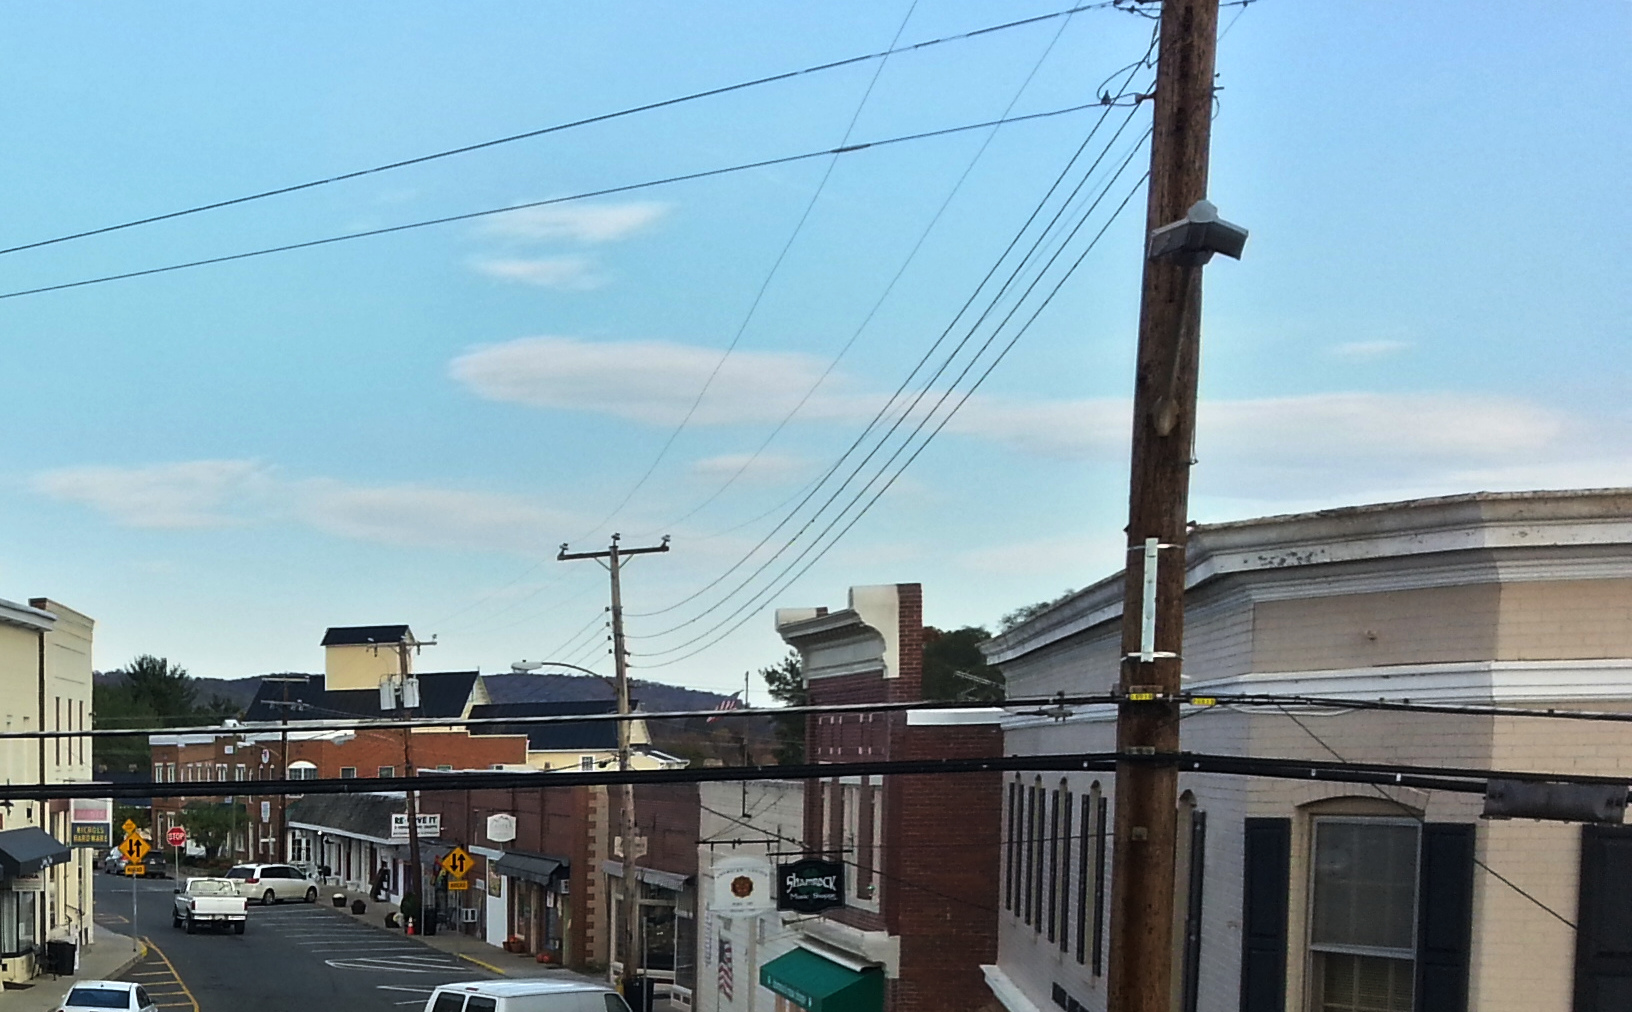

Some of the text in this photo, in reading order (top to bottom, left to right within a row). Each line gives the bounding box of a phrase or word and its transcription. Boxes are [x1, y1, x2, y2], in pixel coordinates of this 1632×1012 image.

[429, 816, 438, 824] IT
[73, 834, 108, 843] HARDWARE
[167, 832, 186, 840] STOP
